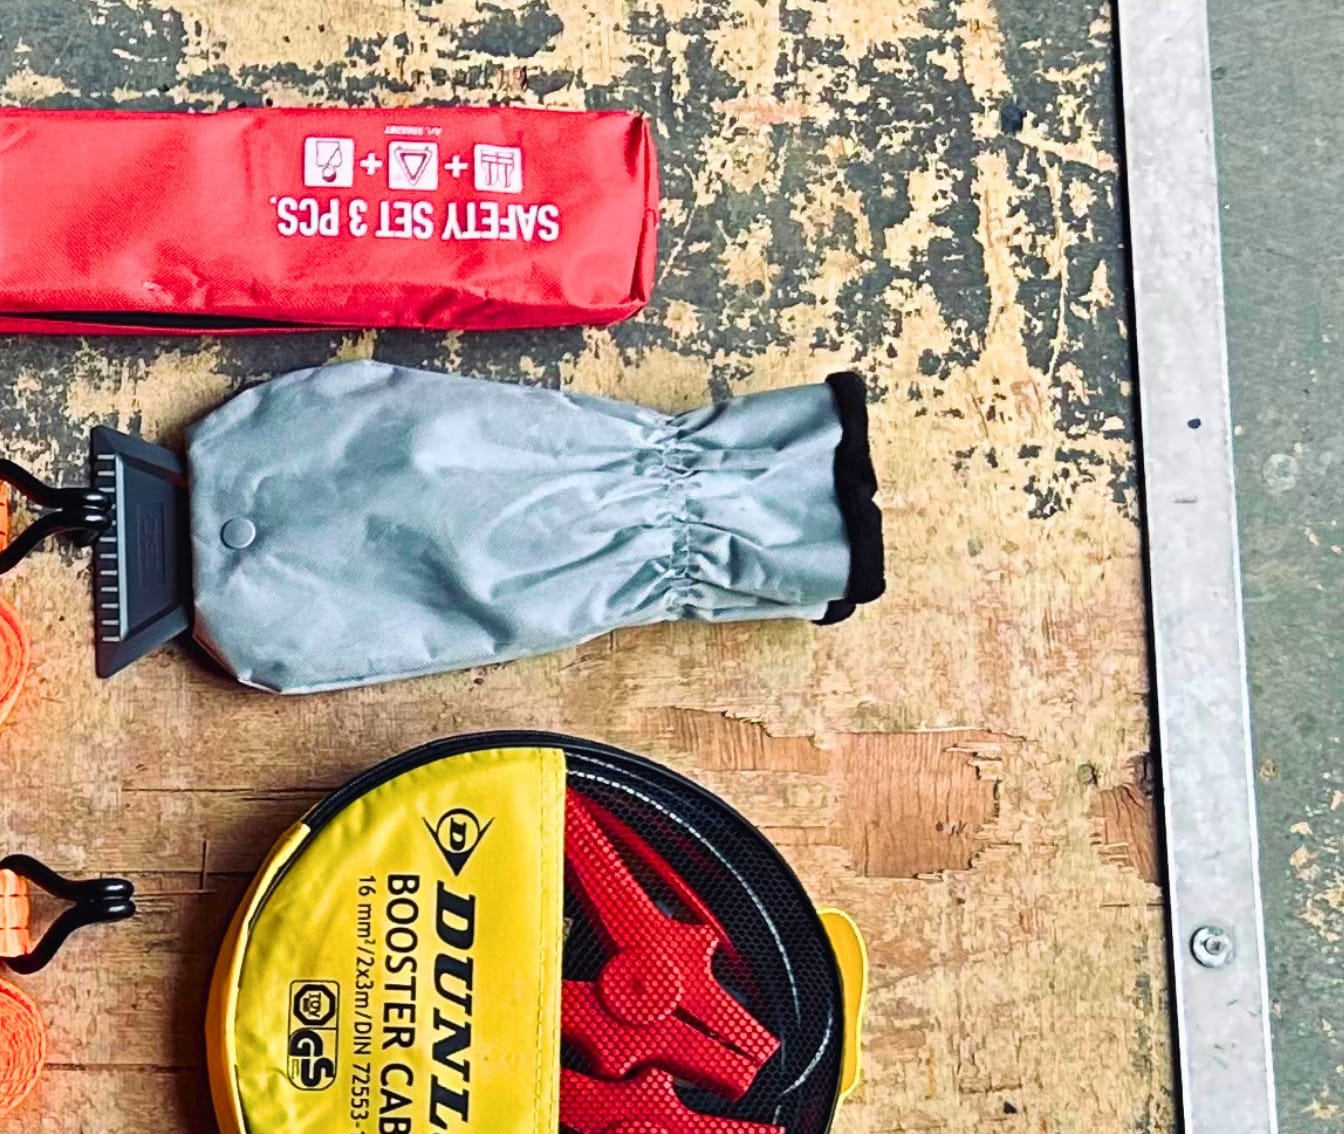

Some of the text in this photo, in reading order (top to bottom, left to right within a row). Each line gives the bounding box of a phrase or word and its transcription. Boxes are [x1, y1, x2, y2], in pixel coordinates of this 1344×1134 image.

[270, 196, 560, 241] SAFETY SET 3 PCS.
[358, 874, 377, 897] 16
[381, 874, 421, 1051] BOOSTER
[288, 1029, 335, 1087] GS
